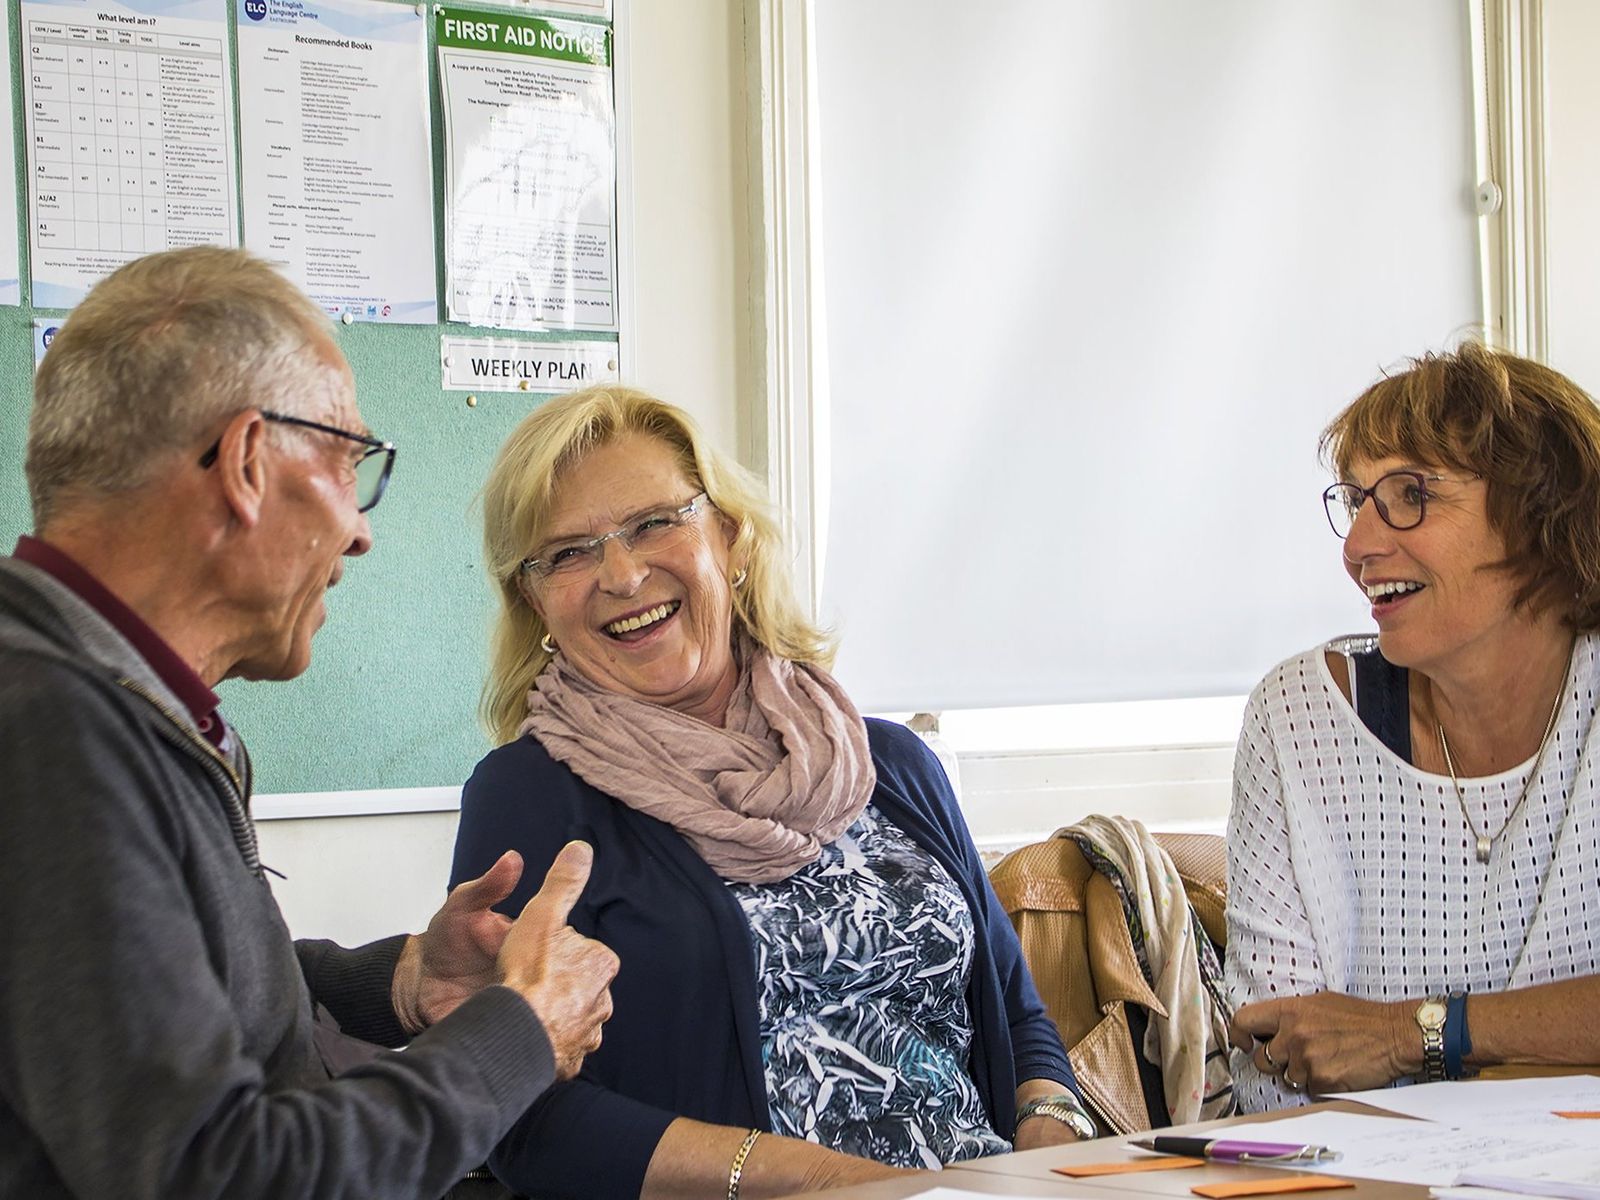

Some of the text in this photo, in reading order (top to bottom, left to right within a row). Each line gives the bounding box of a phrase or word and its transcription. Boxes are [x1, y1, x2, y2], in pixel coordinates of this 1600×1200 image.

[247, 3, 265, 13] ELC
[282, 0, 303, 9] English
[98, 13, 117, 22] What
[118, 15, 136, 24] level
[270, 8, 318, 19] Language Centre
[295, 35, 372, 50] Recommended Books
[445, 19, 604, 55] FIRST AID NOTICE
[471, 358, 592, 379] WEEKLY PLAN
